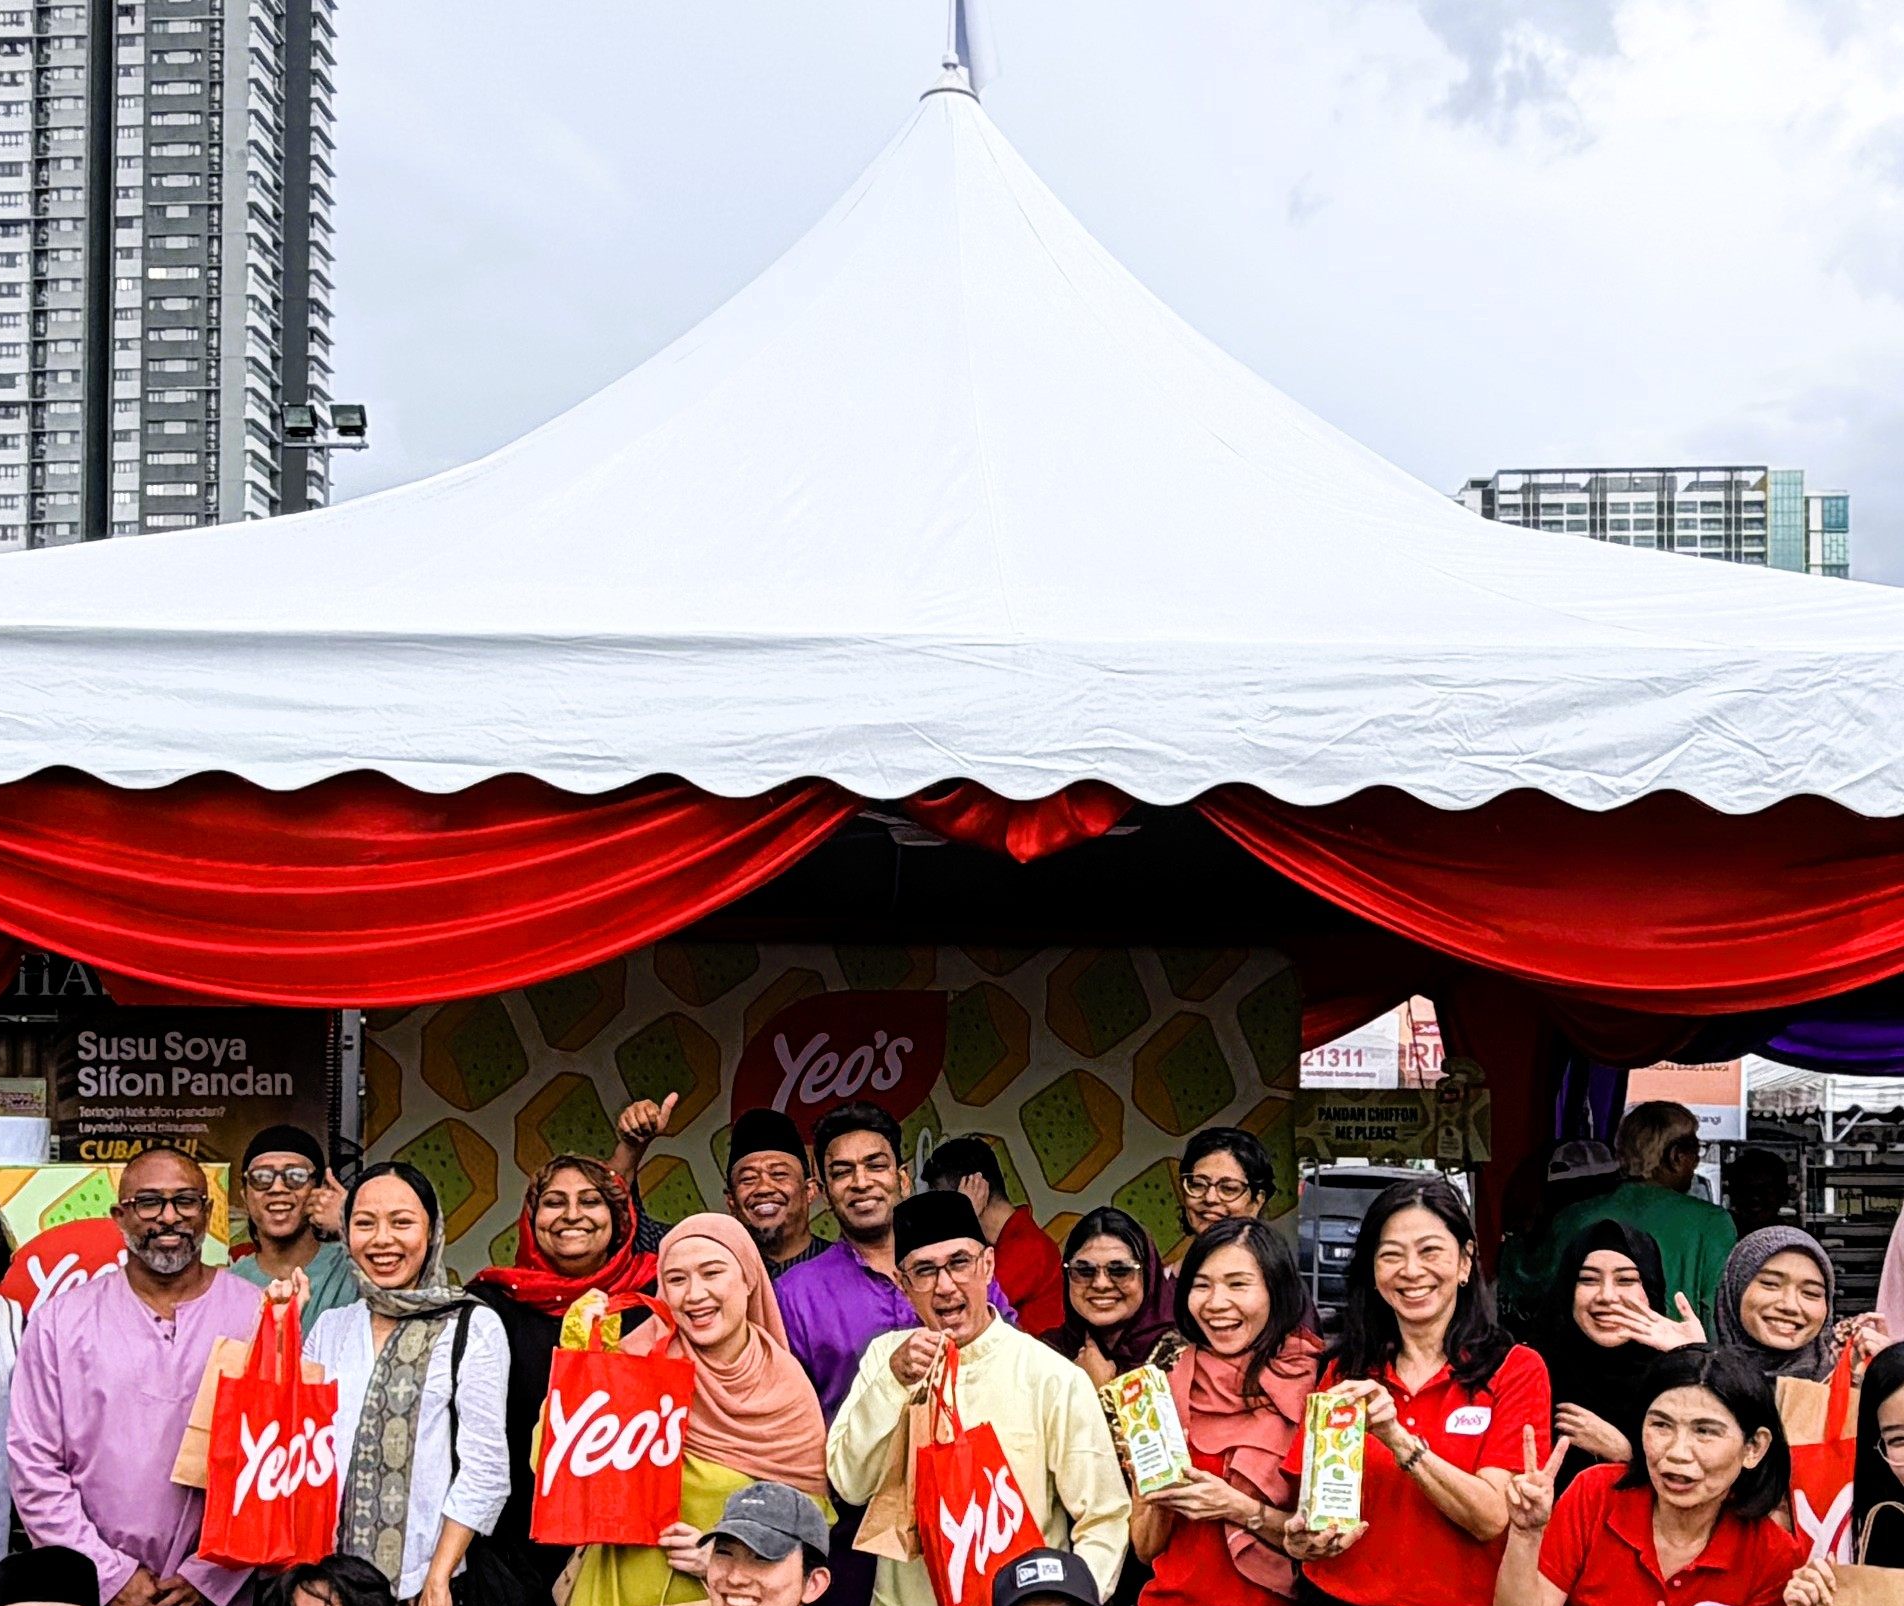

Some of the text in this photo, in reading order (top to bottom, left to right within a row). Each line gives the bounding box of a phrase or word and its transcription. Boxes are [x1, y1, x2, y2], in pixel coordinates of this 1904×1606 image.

[77, 1031, 247, 1067] Susu Soya
[77, 1066, 293, 1098] Sifon Pandan
[771, 1030, 914, 1114] Yeo's
[1367, 1106, 1419, 1122] CHIFFON
[1354, 1126, 1398, 1141] PLEASE
[541, 1388, 689, 1497] Yeo's
[232, 1411, 337, 1517] Yeo's
